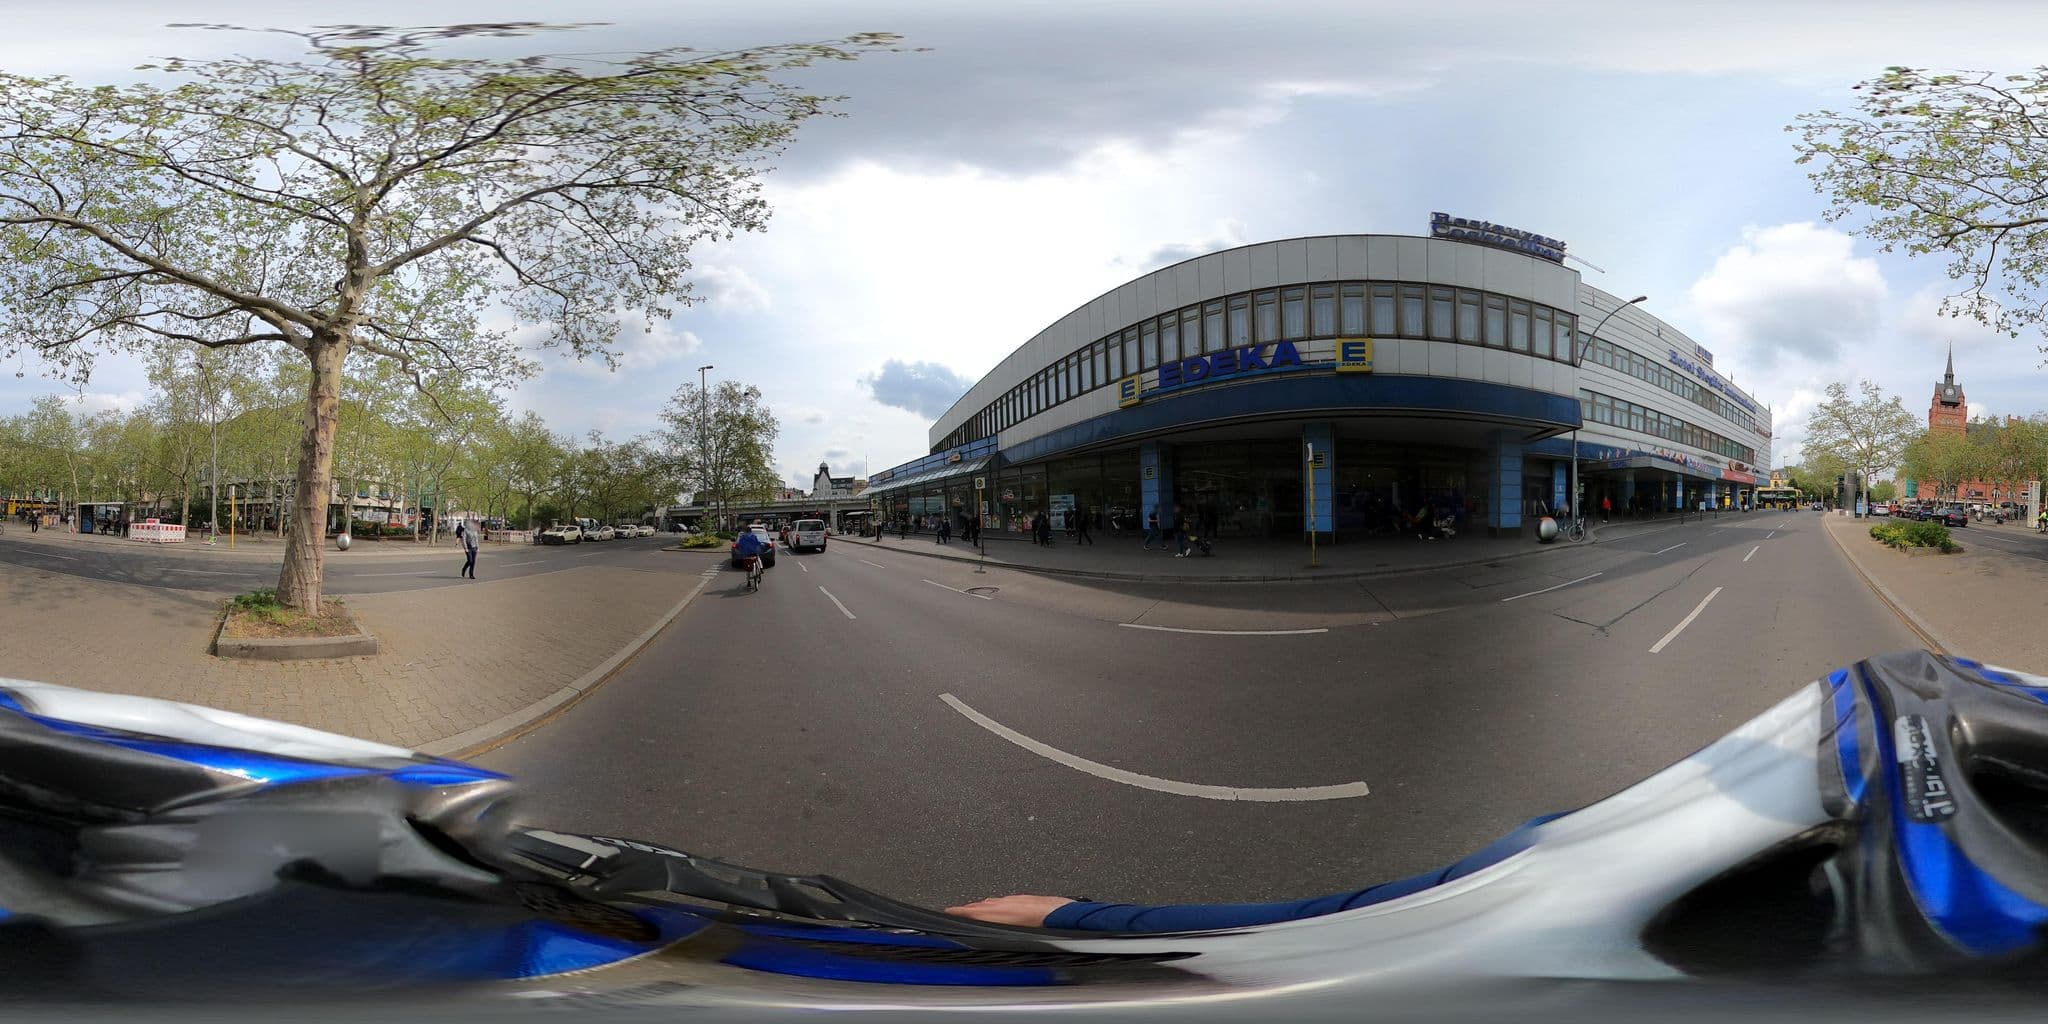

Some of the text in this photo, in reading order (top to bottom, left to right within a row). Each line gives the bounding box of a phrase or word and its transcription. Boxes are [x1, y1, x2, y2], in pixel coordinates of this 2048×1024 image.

[1430, 211, 1567, 250] Restaurant
[1158, 340, 1302, 388] EDEKA
[1342, 341, 1366, 361] E
[1121, 378, 1136, 398] E
